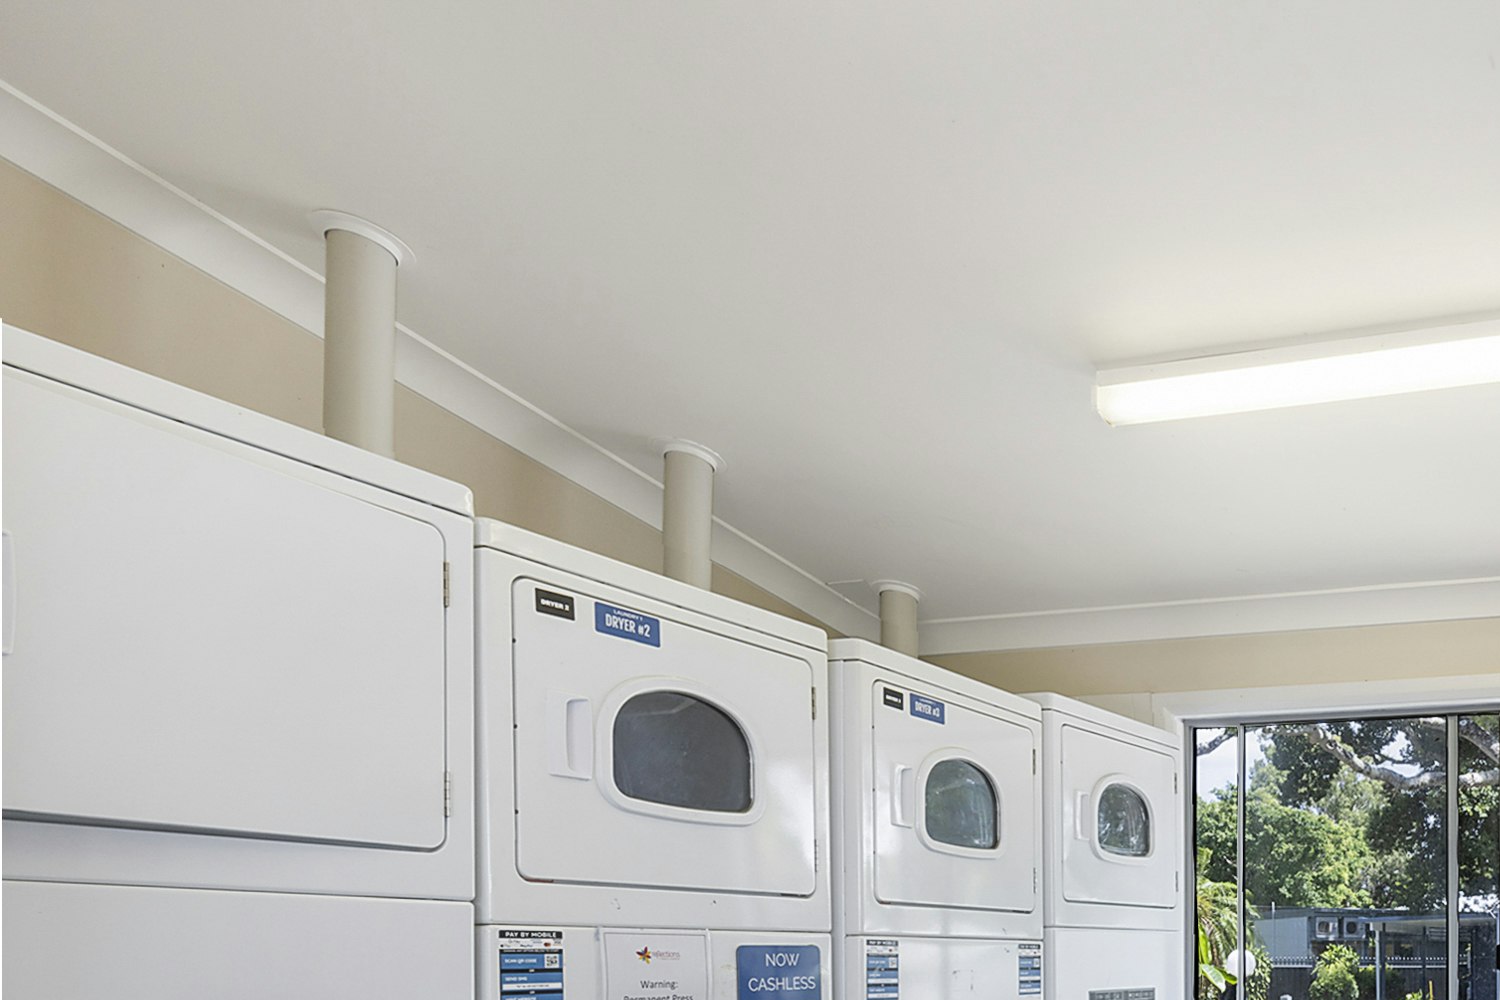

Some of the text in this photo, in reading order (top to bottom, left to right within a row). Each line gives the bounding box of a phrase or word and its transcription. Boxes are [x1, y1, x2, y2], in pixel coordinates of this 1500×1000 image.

[605, 613, 651, 638] DRYER #2
[765, 953, 799, 967] NOW
[640, 980, 679, 990] Warning:
[748, 976, 816, 992] CASHLESS
